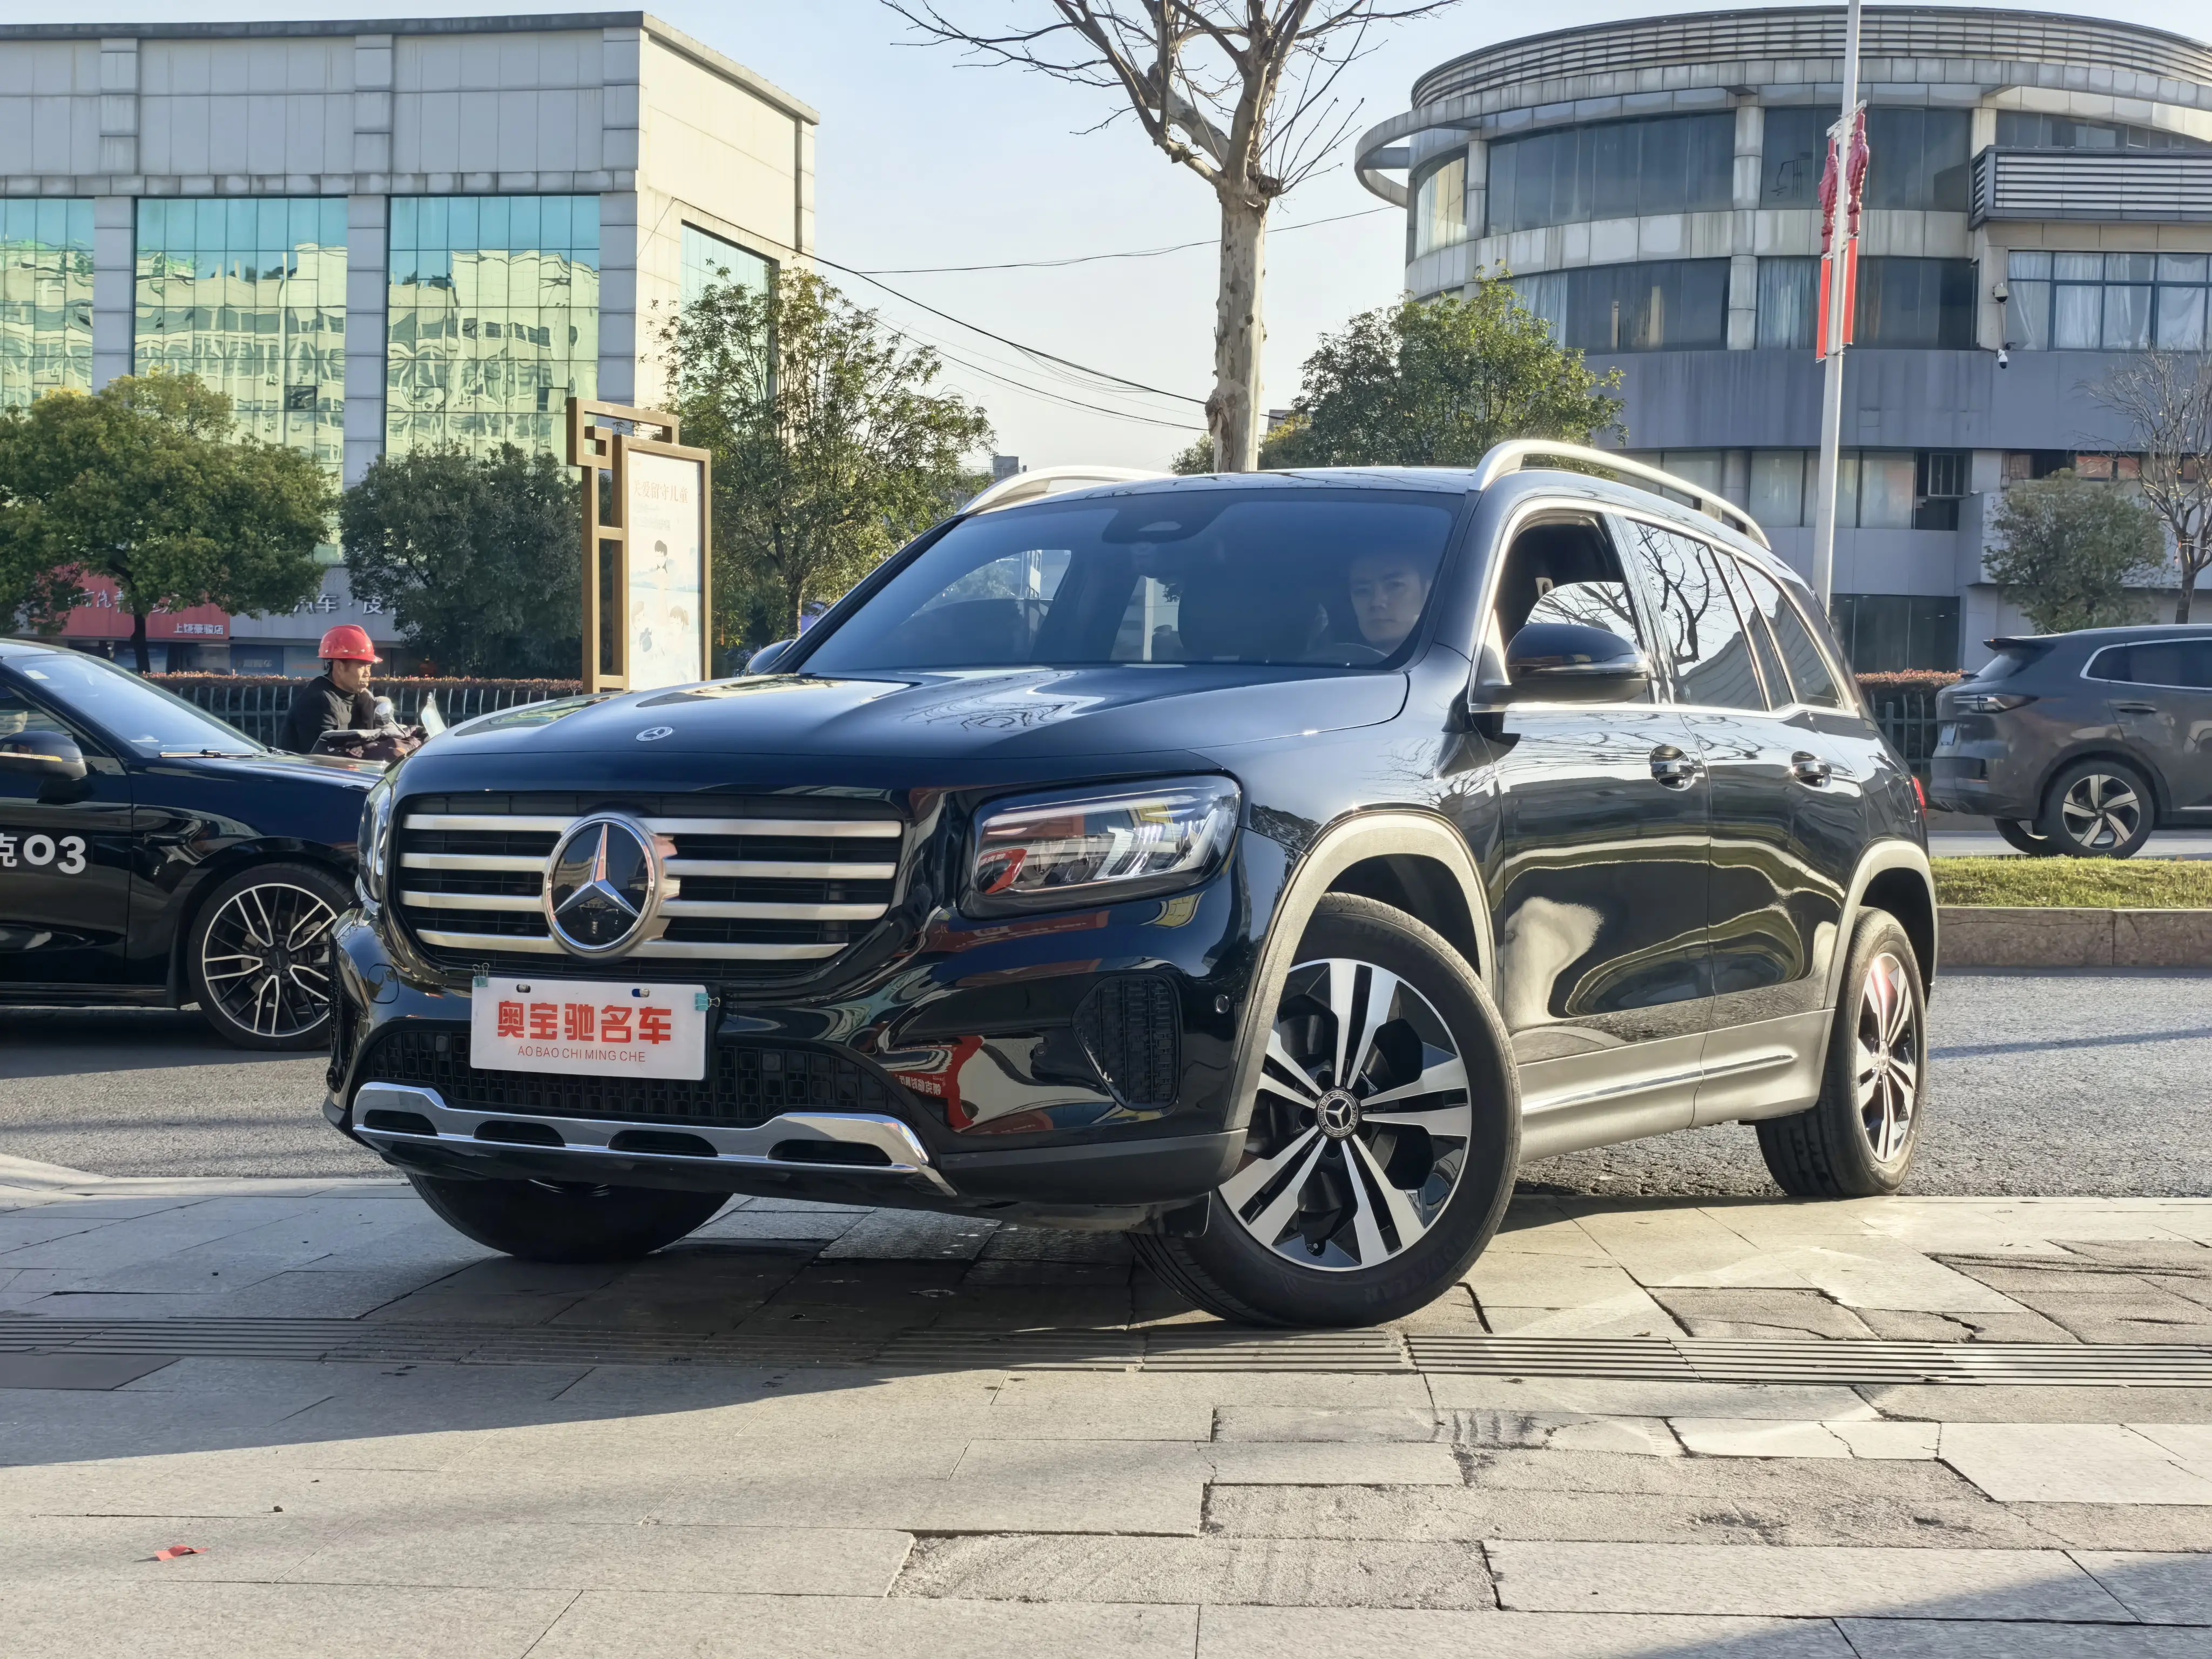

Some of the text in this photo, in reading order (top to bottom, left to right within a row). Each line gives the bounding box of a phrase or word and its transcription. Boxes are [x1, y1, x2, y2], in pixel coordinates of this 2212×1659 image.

[633, 480, 689, 503] 关爱留守儿童
[497, 1000, 672, 1044] 奥宝驰名车
[517, 1046, 646, 1062] AO BAO CHI MING CHE
[1319, 1095, 1331, 1126] MERCEDES
